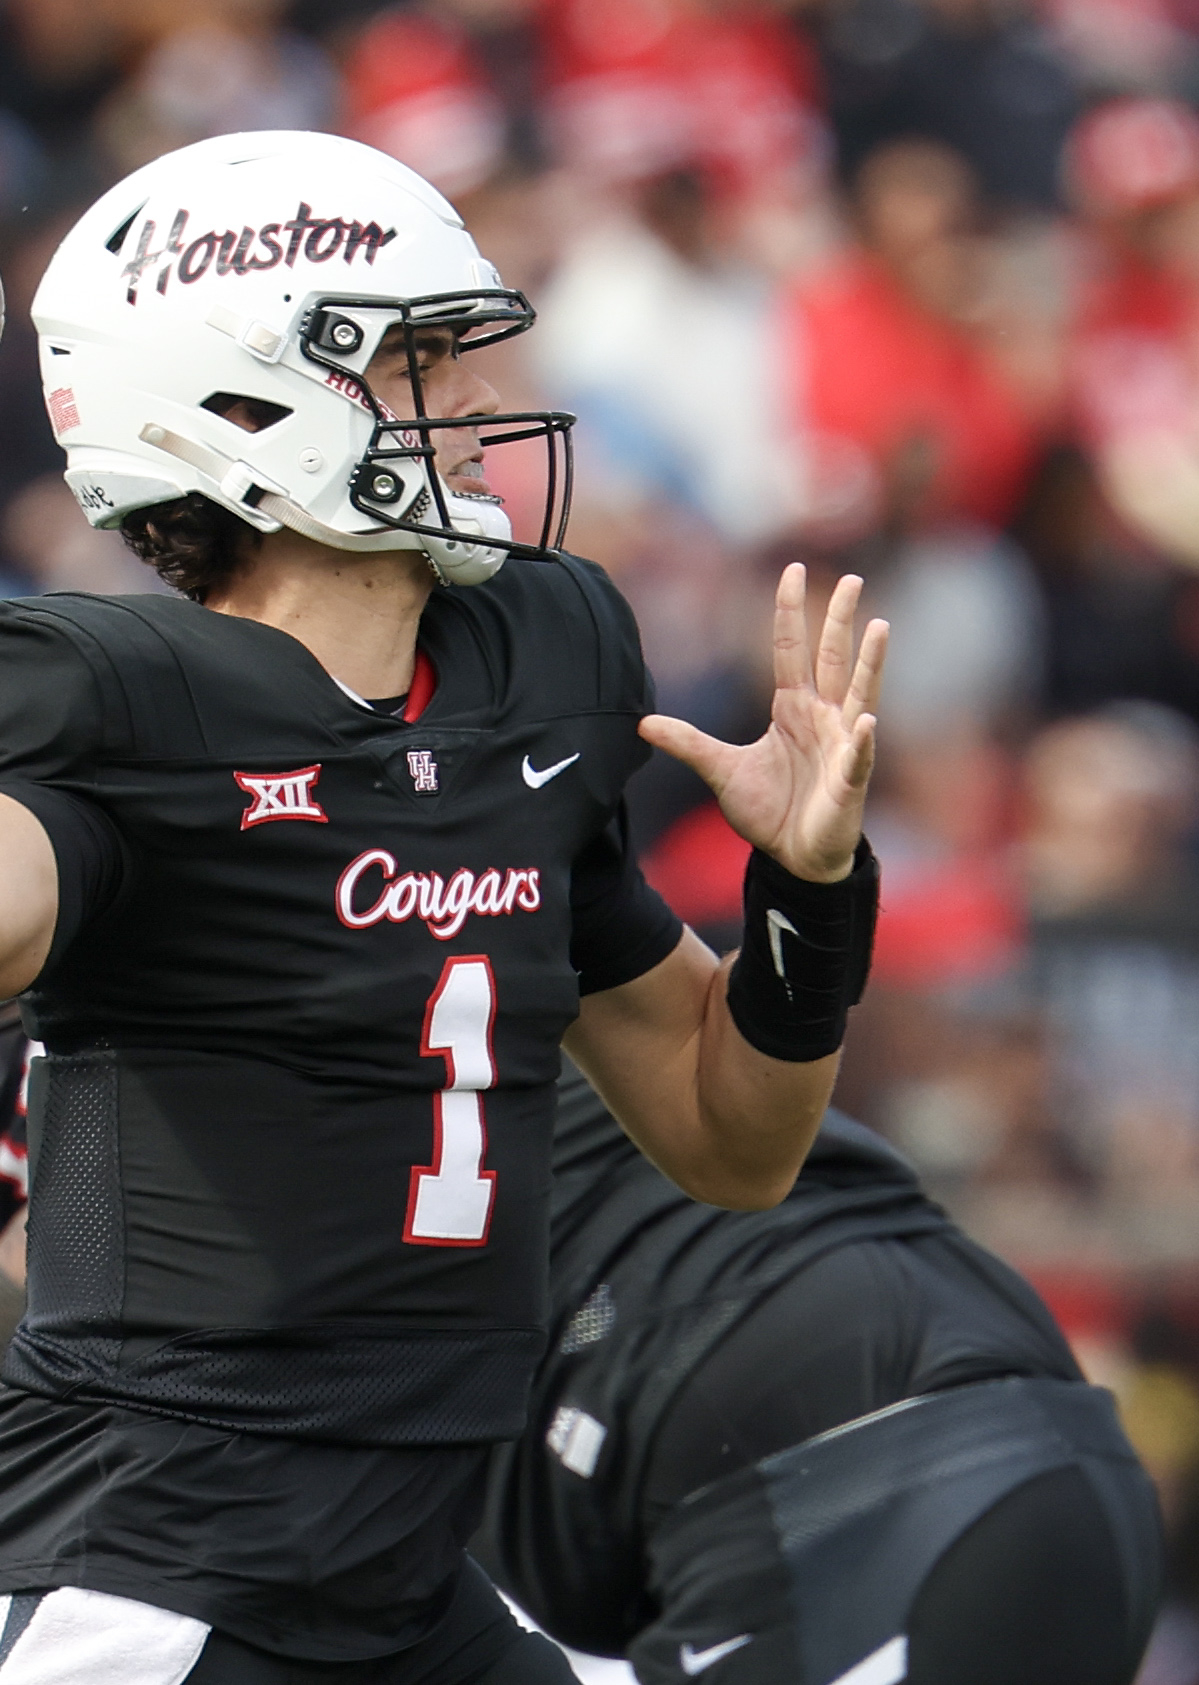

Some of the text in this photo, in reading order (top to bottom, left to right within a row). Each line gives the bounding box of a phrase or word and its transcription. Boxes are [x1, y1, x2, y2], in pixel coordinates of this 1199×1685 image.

[120, 201, 398, 307] Houston
[238, 769, 324, 825] XII
[406, 750, 438, 792] UH
[335, 847, 542, 941] Cougars
[403, 954, 498, 1247] 1
